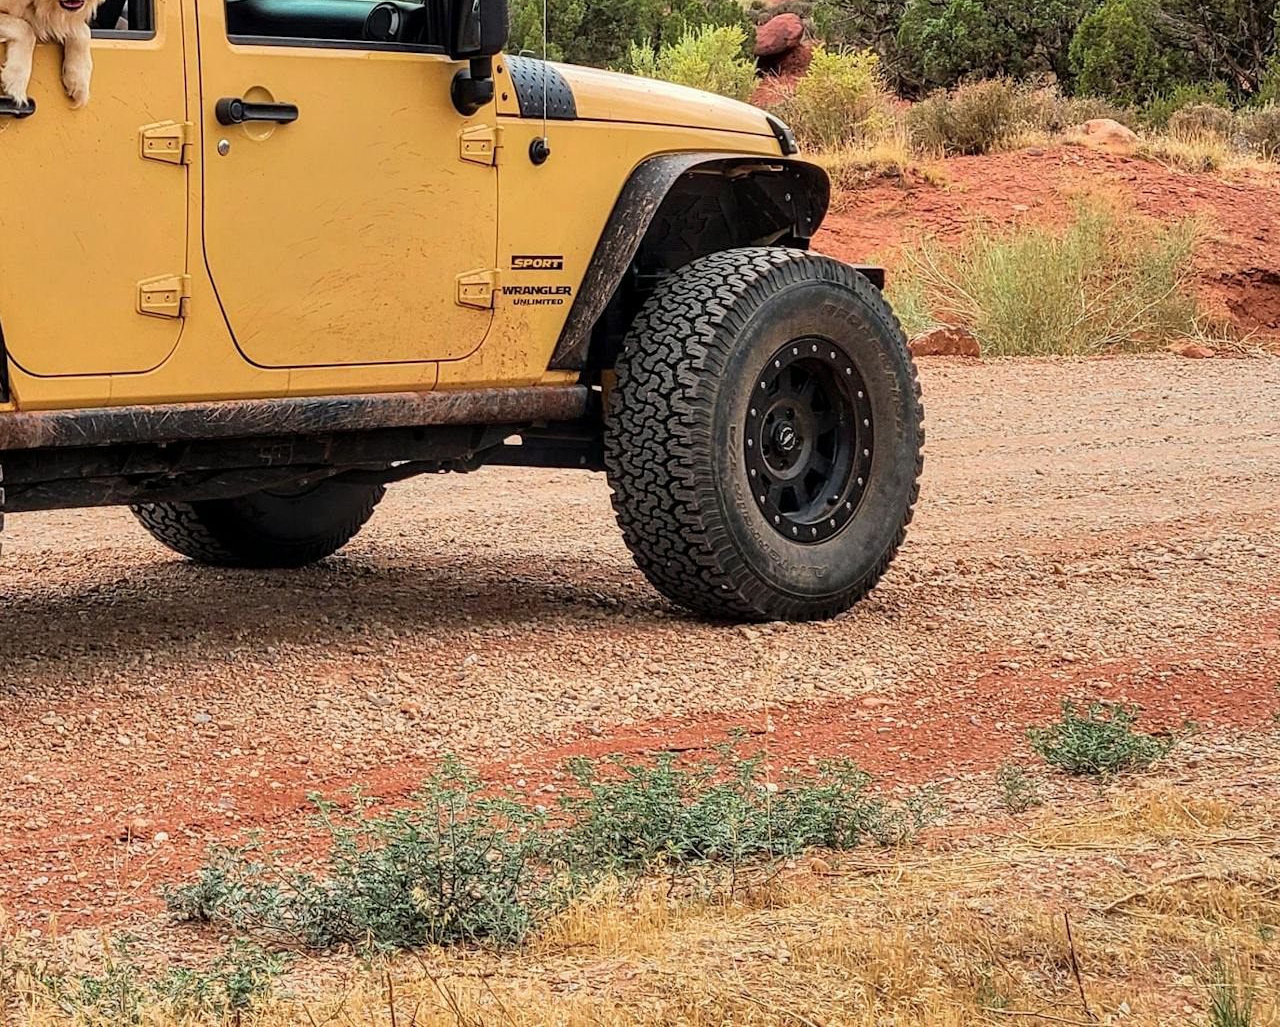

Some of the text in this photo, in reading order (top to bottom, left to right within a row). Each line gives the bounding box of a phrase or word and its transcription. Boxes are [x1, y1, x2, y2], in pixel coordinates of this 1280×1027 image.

[511, 256, 563, 270] SPORT
[502, 286, 572, 296] WRANGLER
[513, 298, 564, 306] UNLIMITED
